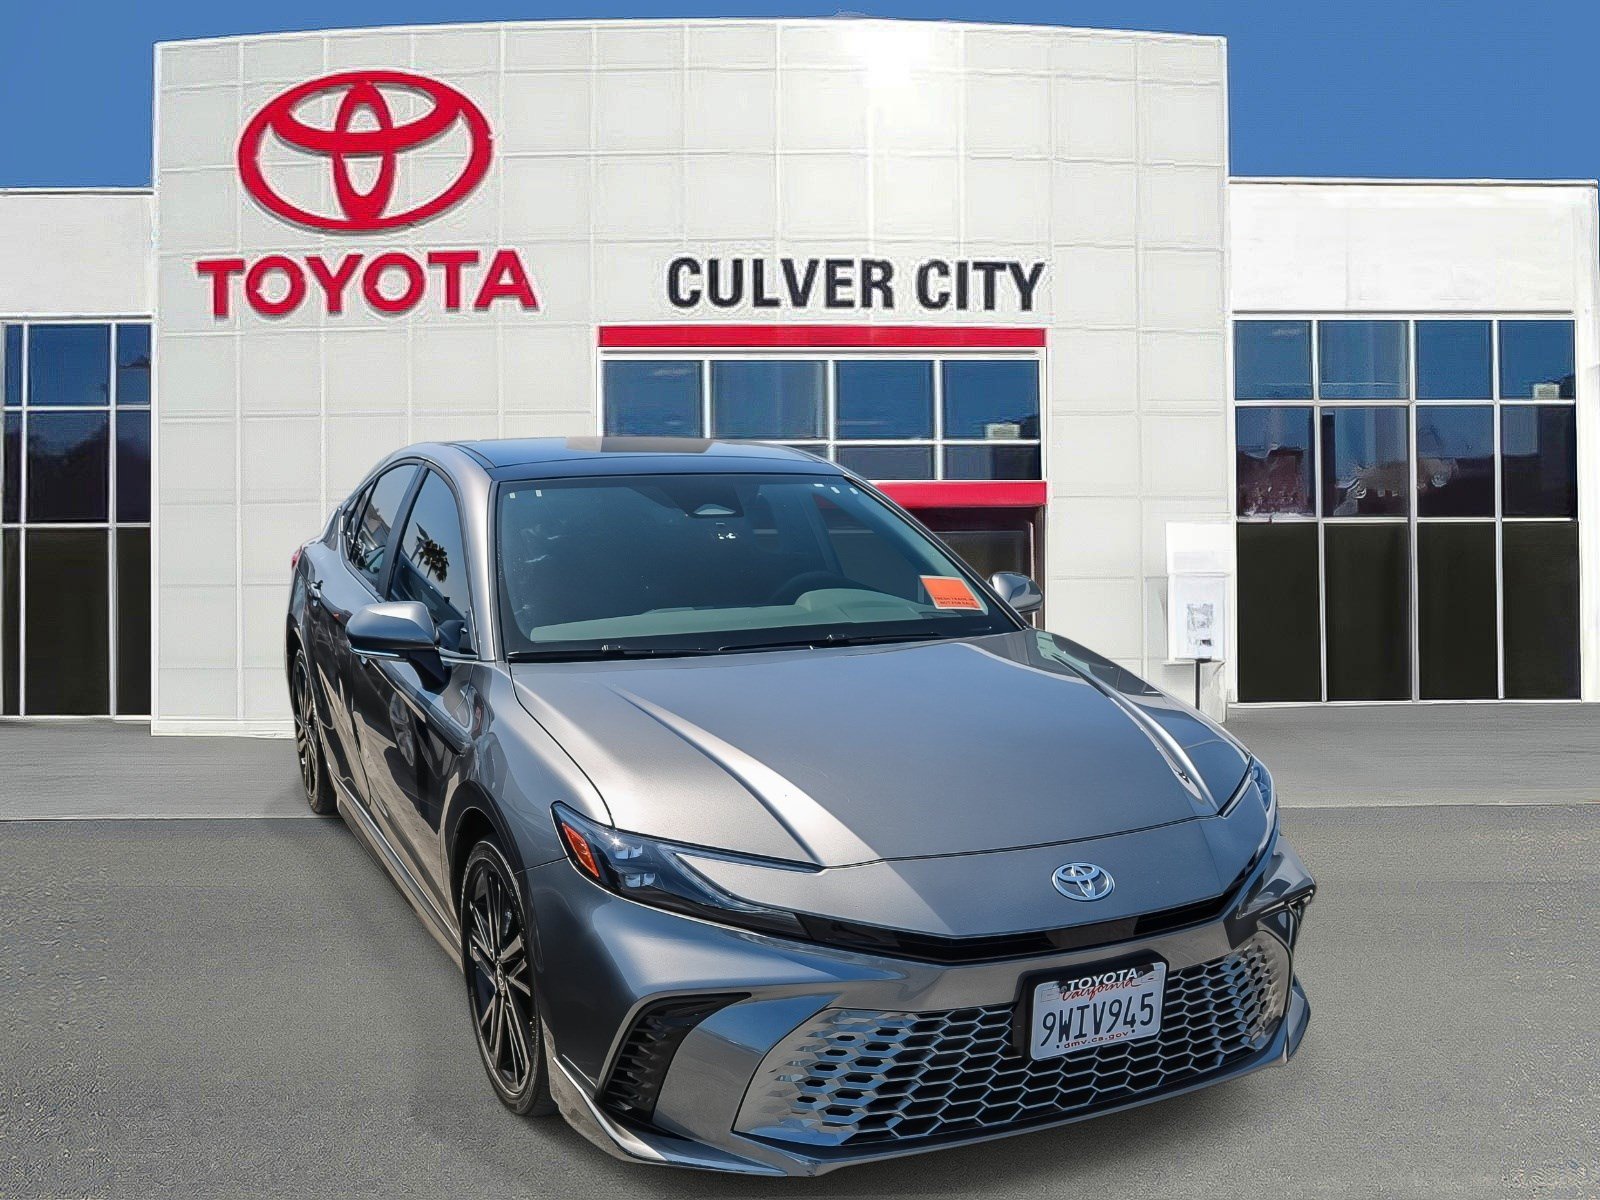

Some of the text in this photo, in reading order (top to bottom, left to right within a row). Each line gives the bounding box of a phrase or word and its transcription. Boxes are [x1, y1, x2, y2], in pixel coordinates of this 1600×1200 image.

[196, 249, 540, 320] TOYOTA
[667, 256, 1046, 312] CULVER CITY
[1067, 967, 1138, 991] TOYOTA
[1040, 991, 1155, 1047] 9WIV945
[1063, 1031, 1129, 1049] dmv.ca.gov
